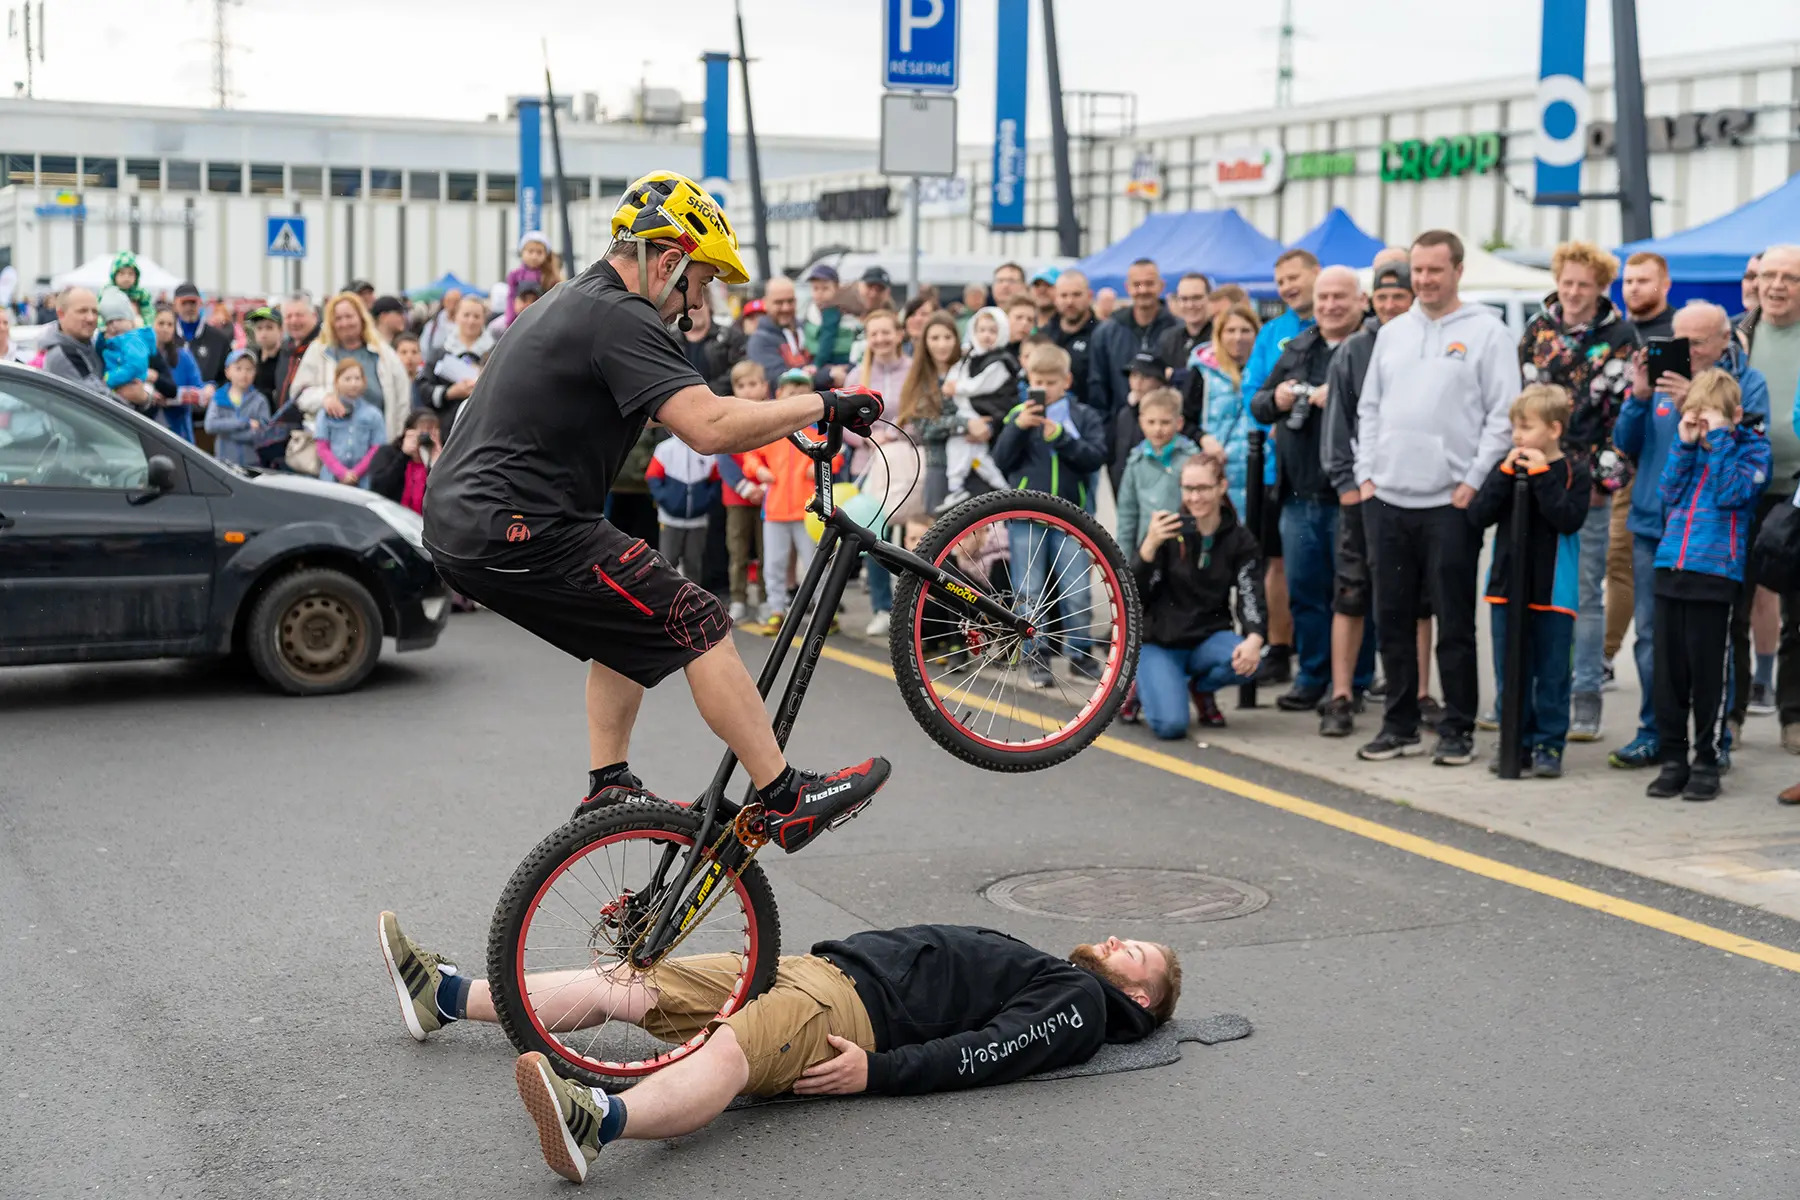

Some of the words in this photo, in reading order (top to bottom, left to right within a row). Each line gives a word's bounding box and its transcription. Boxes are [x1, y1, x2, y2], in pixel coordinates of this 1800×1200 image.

[899, 0, 945, 53] P
[1380, 131, 1500, 182] CROPP
[945, 582, 978, 604] SHOCK!
[1115, 567, 1138, 692] SCHWALBE
[805, 782, 852, 804] hebo
